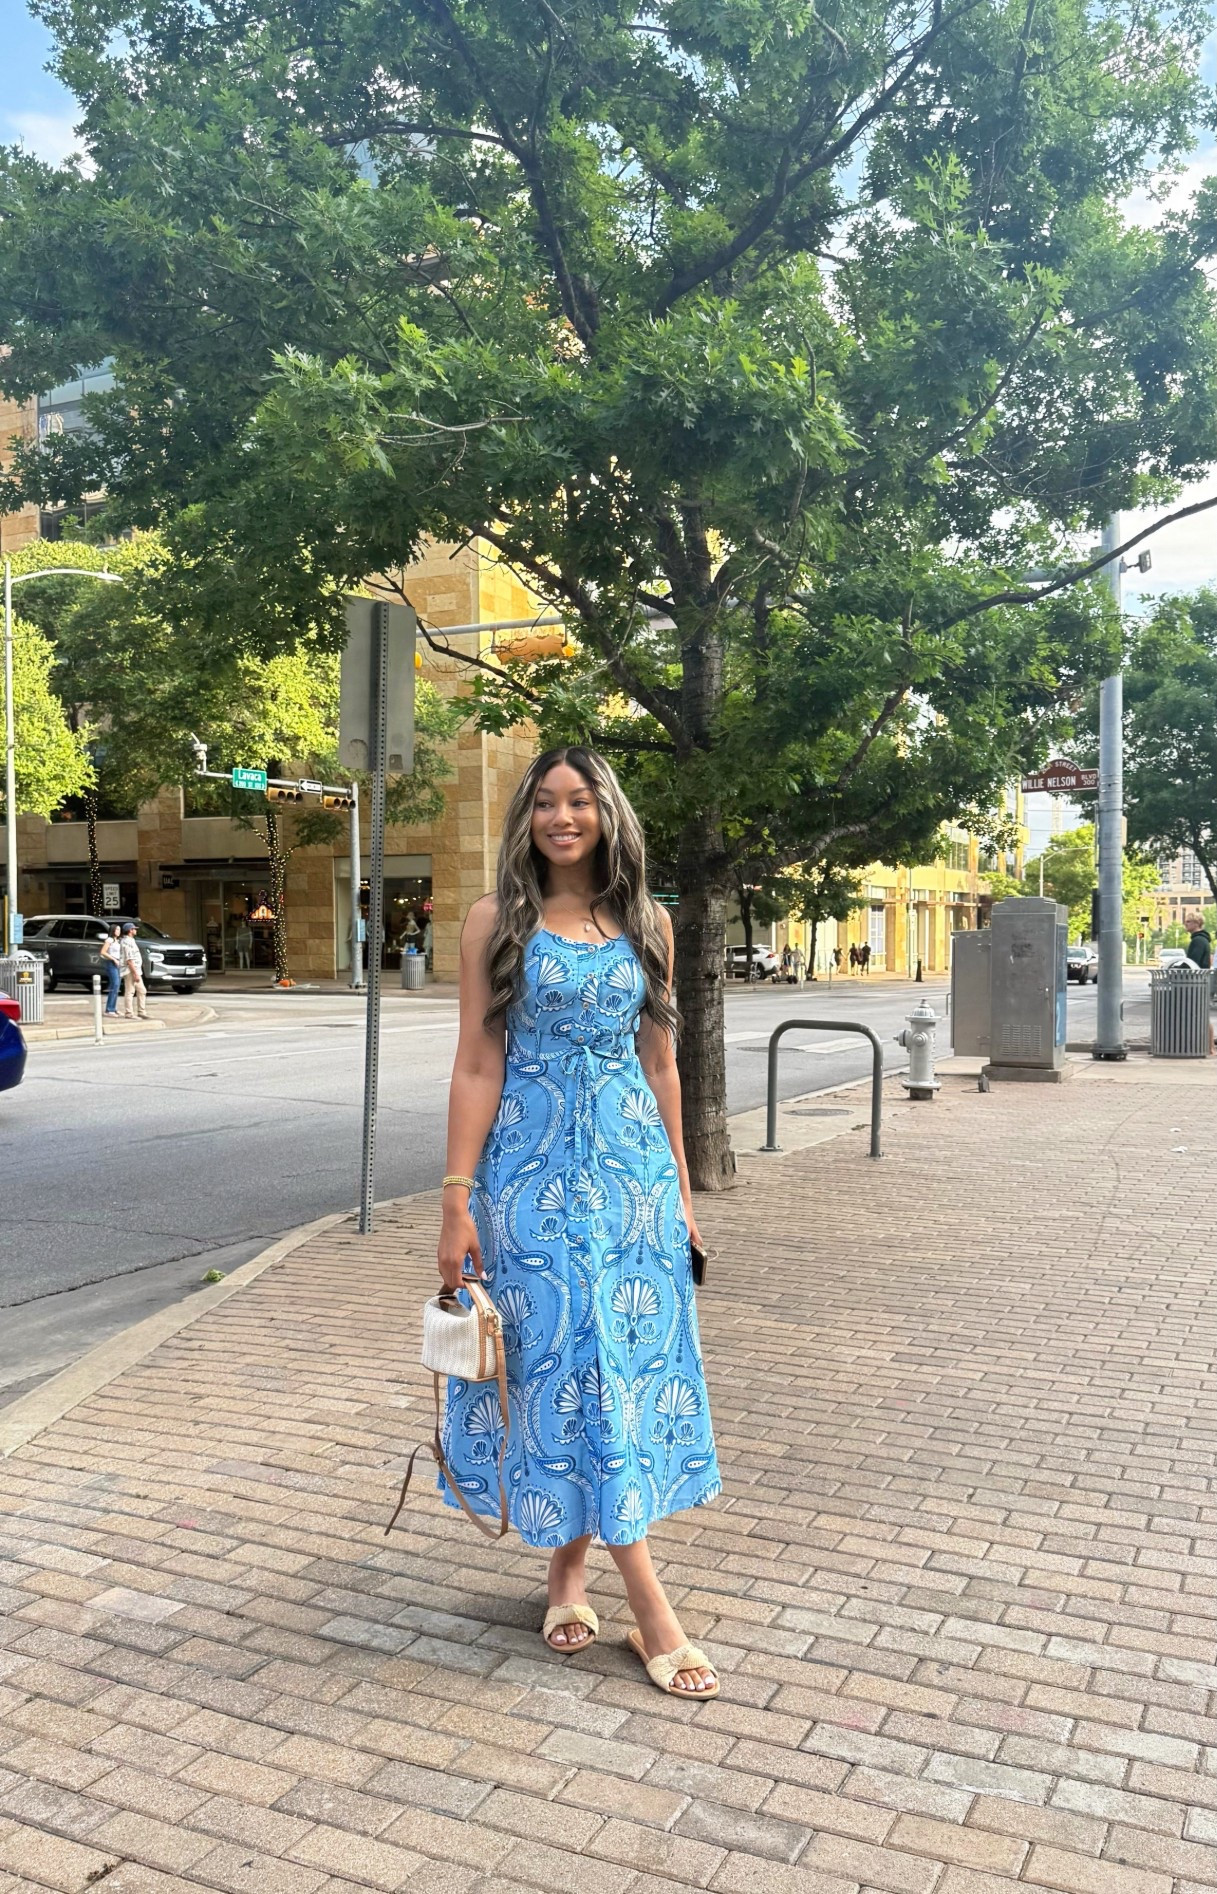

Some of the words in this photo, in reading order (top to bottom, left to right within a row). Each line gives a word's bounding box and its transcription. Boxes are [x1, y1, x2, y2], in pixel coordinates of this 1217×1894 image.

[1055, 761, 1078, 772] STREET
[238, 770, 262, 782] Lavaca
[1022, 778, 1044, 790] WILLIE
[1047, 776, 1076, 788] NELSON
[105, 897, 119, 906] 25
